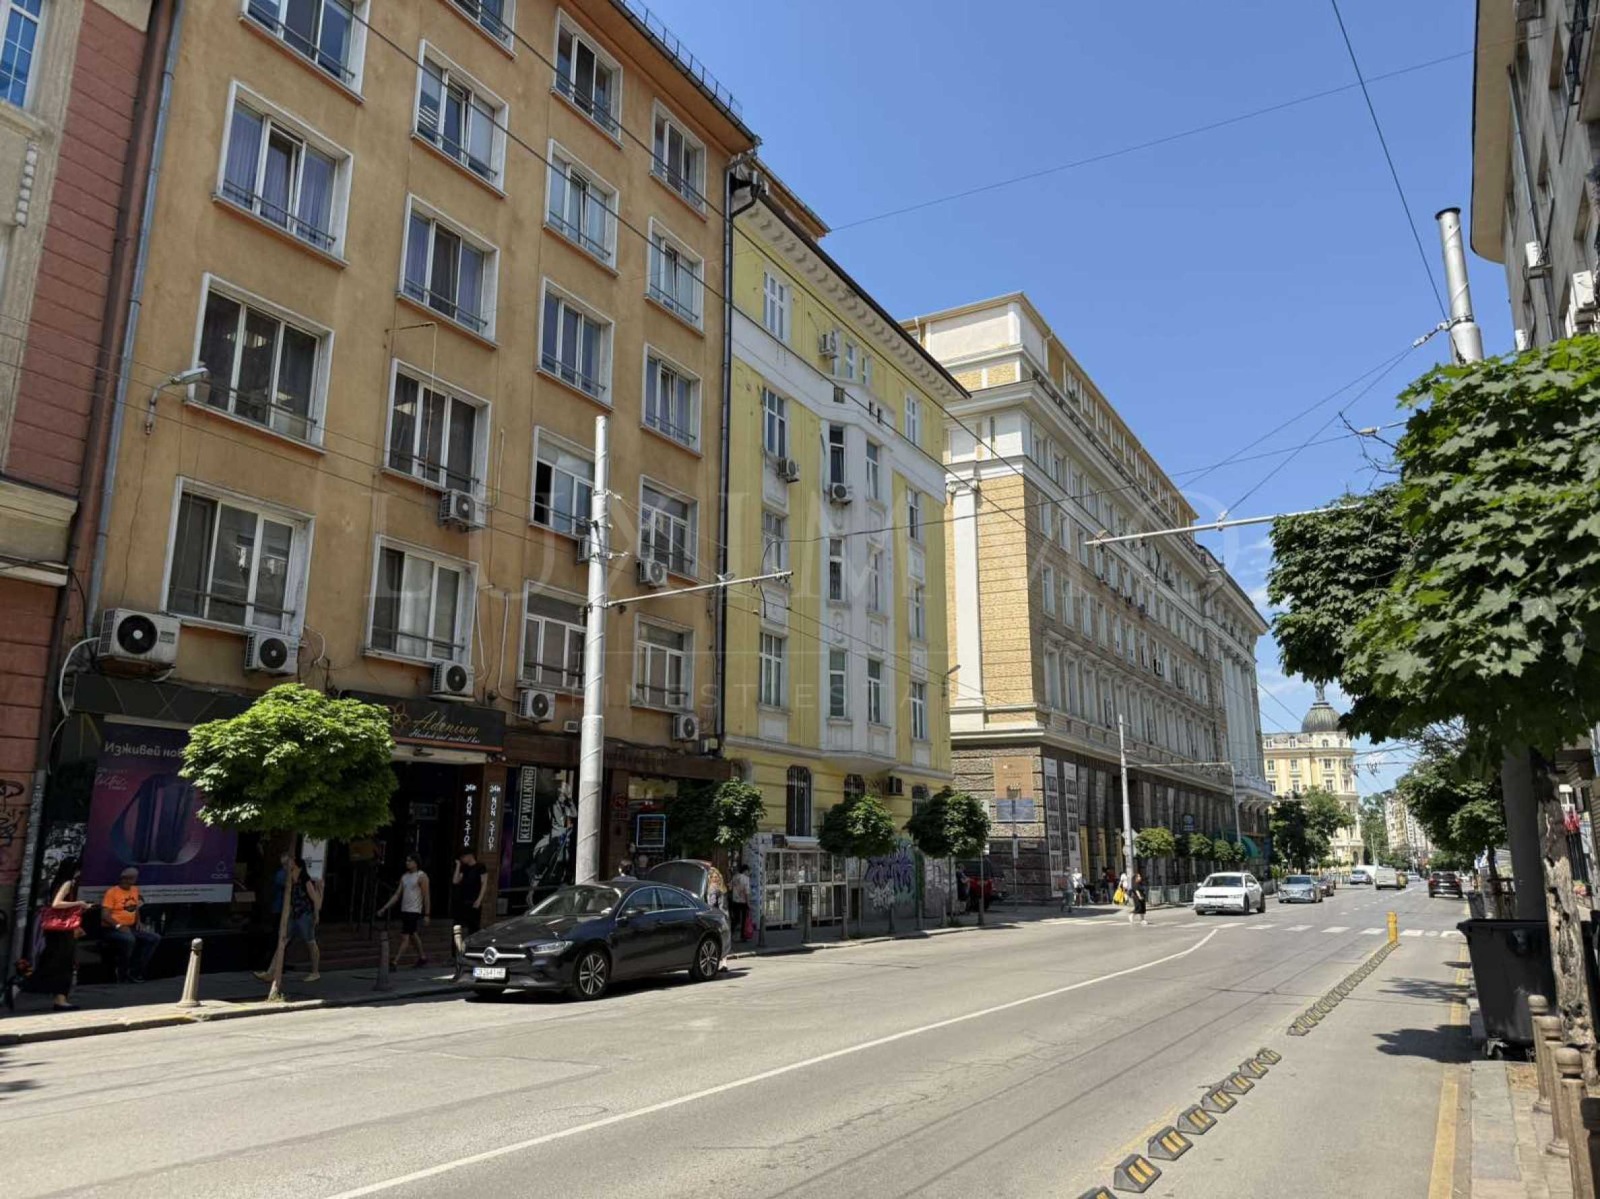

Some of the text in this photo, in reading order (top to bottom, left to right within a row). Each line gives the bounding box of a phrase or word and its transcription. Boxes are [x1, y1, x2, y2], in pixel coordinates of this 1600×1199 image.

[104, 741, 185, 758] Изживей нов
[520, 769, 534, 840] KEEP WALKING
[488, 820, 496, 851] STOP
